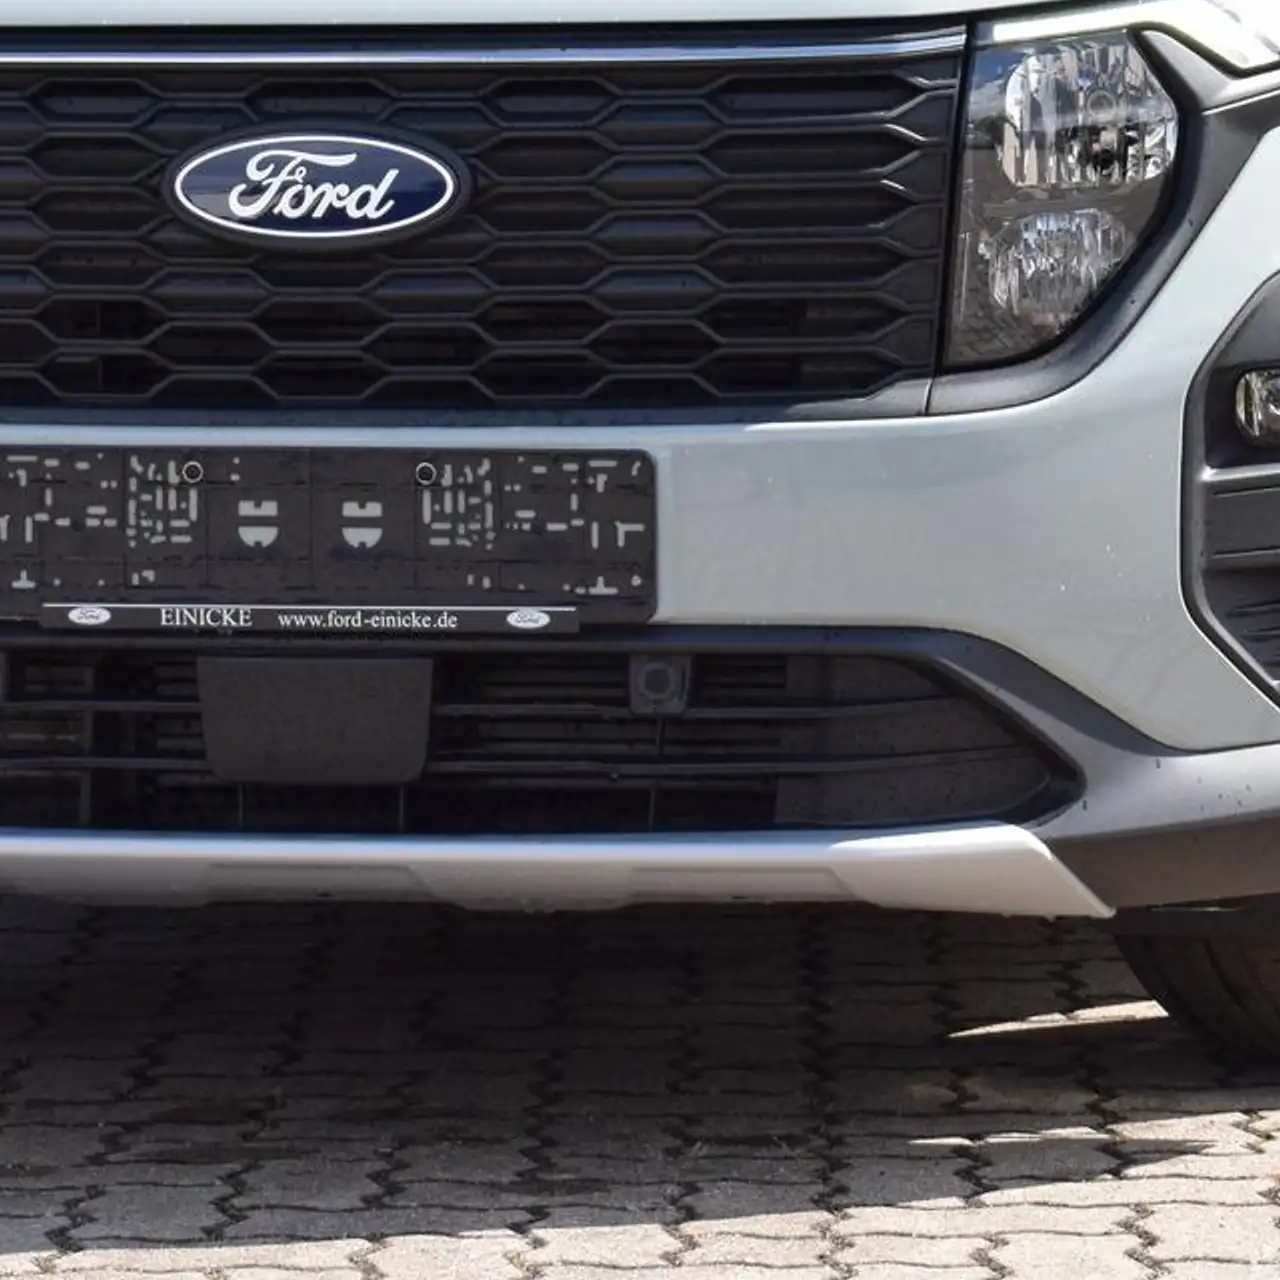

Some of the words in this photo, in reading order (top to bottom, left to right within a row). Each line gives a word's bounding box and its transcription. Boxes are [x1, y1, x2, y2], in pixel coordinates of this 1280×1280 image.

[228, 149, 400, 220] Ford
[160, 607, 253, 627] EINICKE
[277, 609, 459, 629] www.ford-einicke.de
